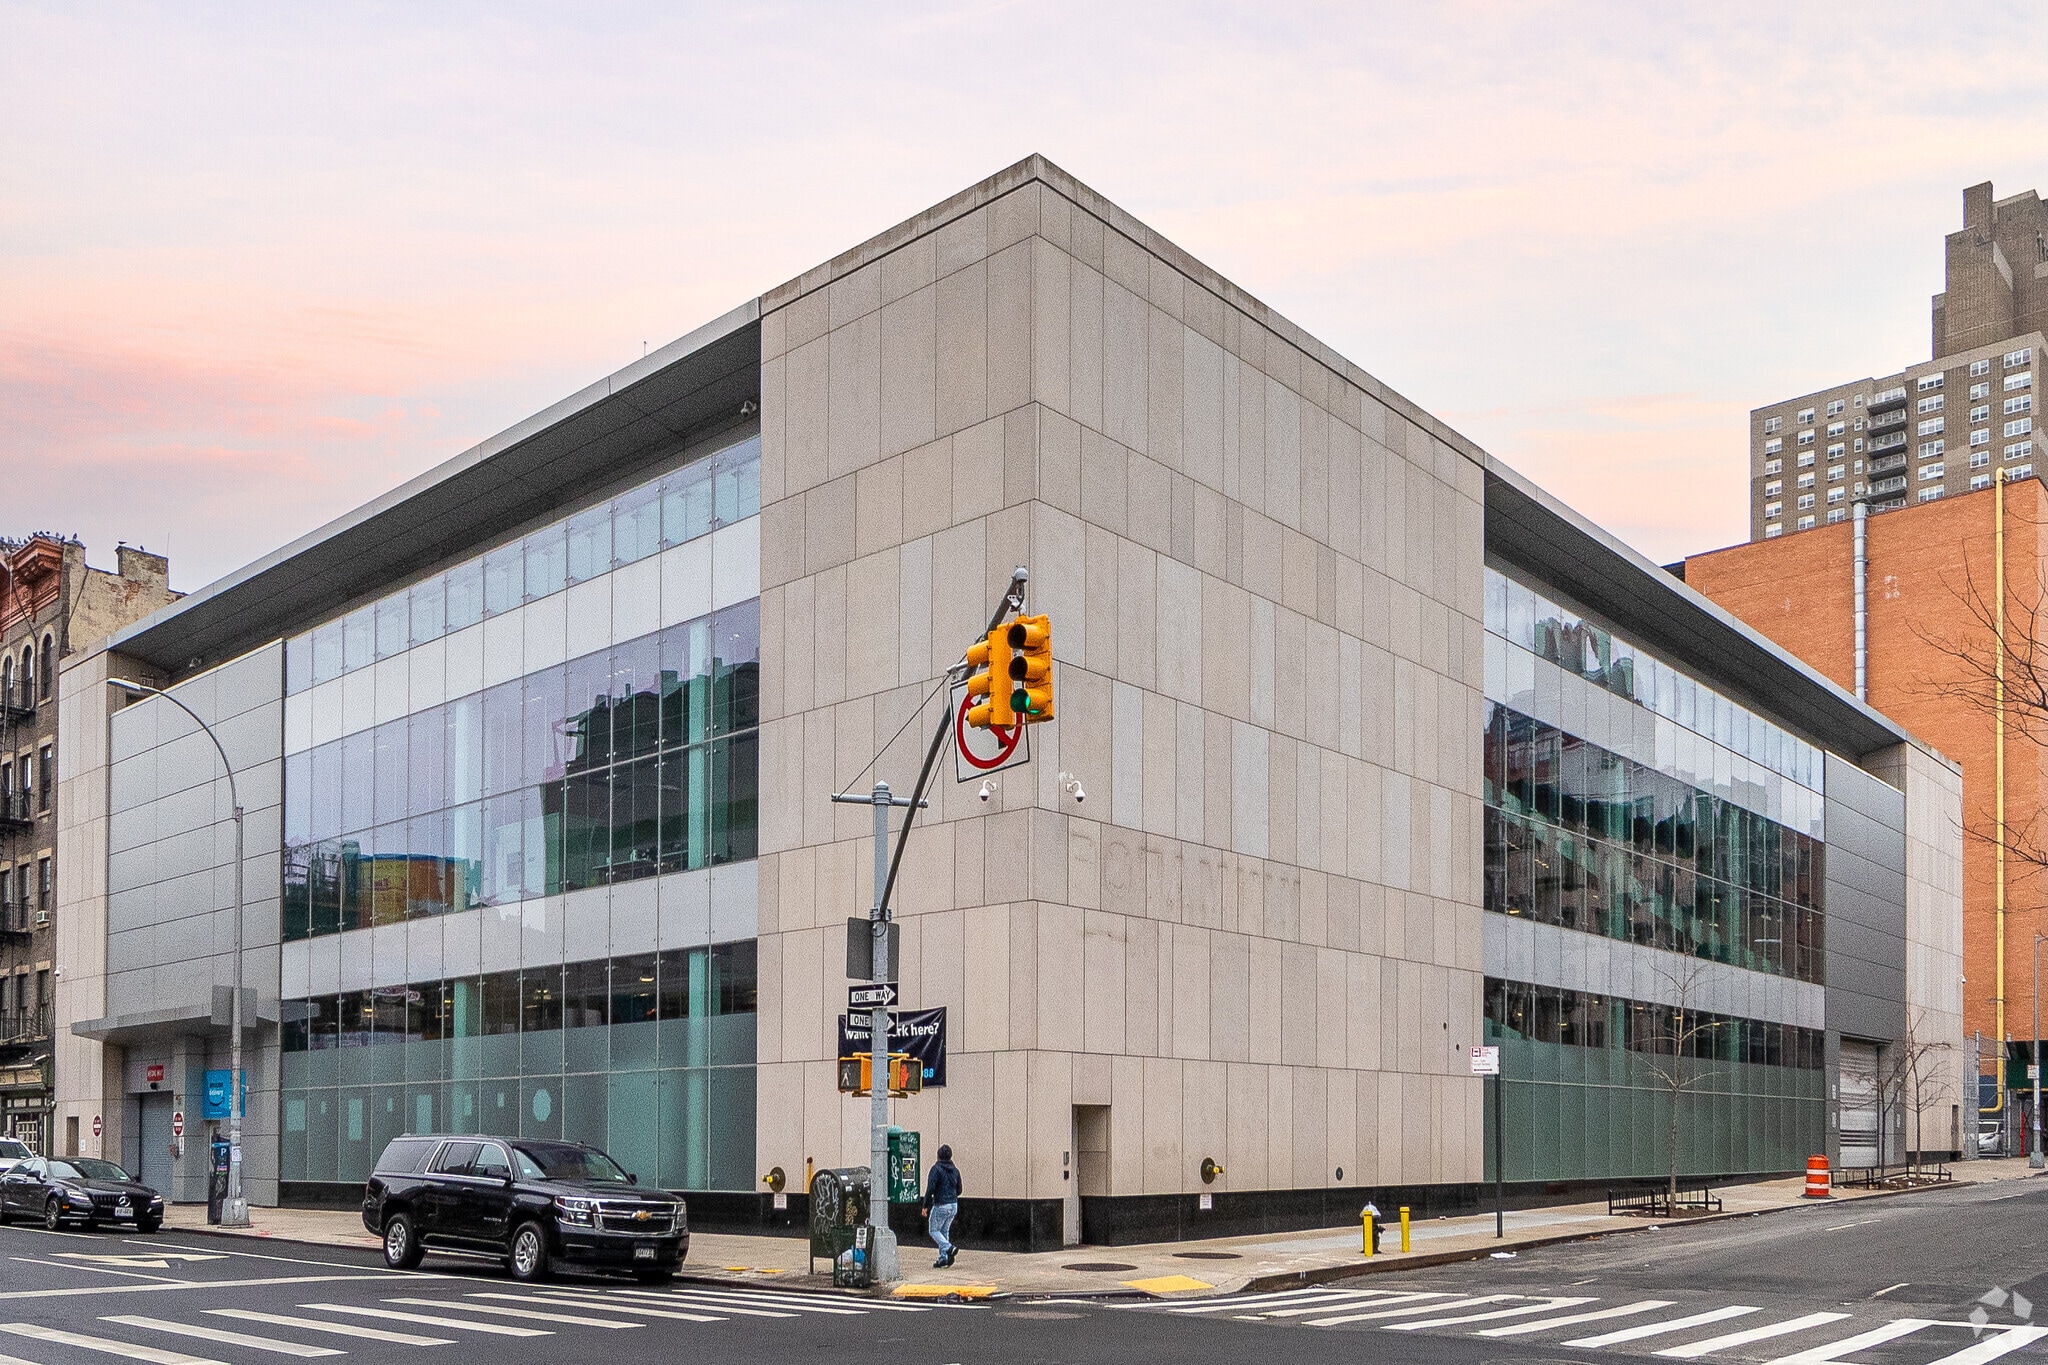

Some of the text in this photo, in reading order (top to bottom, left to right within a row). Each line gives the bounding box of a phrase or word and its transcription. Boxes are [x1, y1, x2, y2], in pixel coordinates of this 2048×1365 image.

[855, 990, 890, 1001] ONE WAY
[854, 1015, 869, 1025] ONE
[910, 1022, 940, 1037] here?
